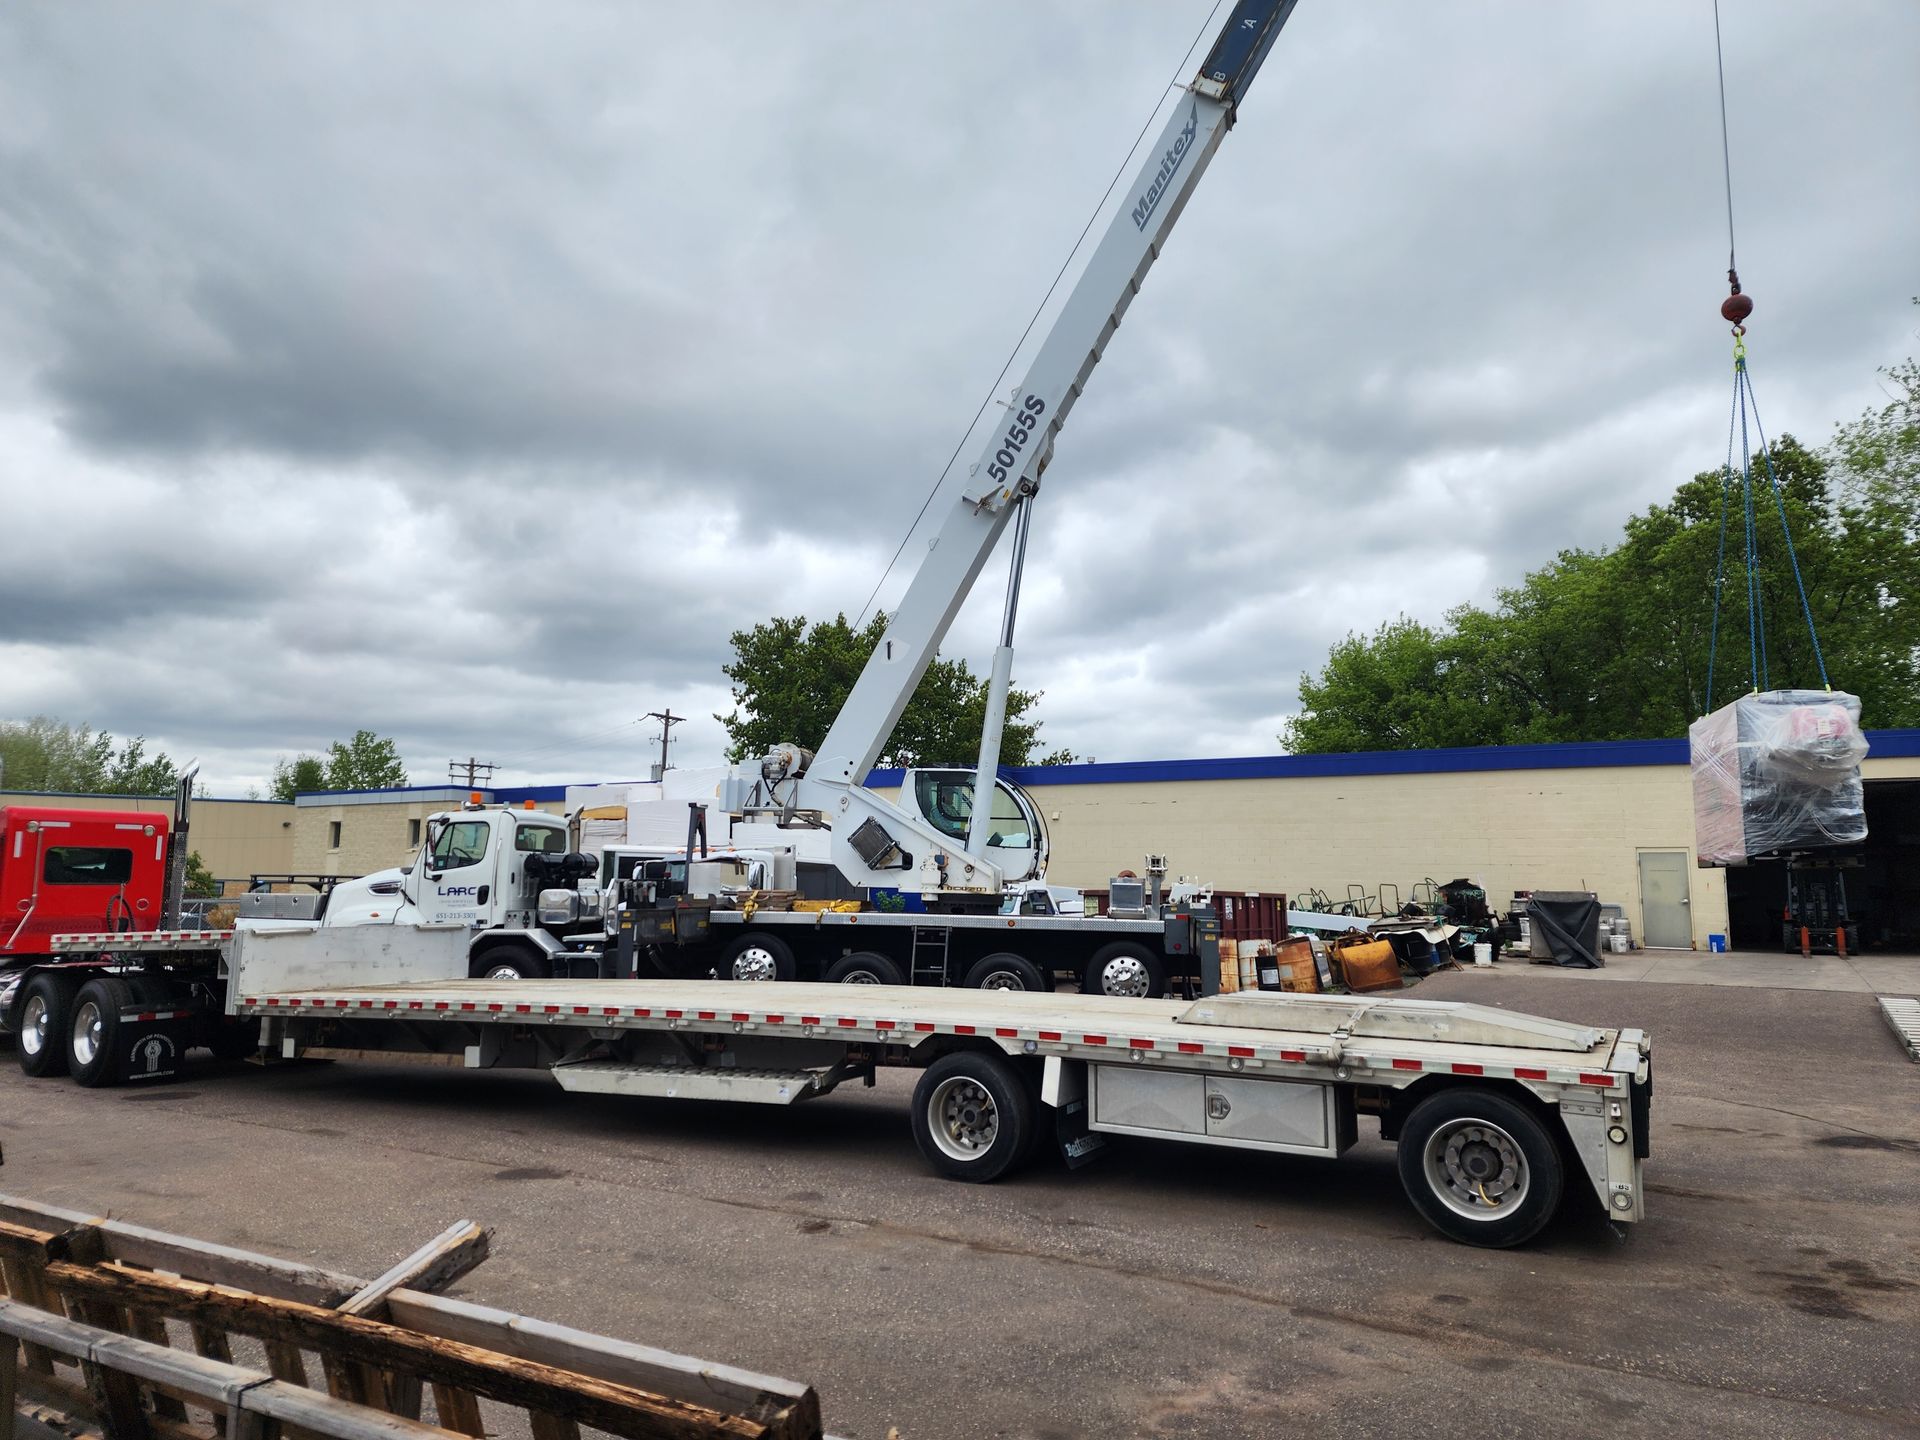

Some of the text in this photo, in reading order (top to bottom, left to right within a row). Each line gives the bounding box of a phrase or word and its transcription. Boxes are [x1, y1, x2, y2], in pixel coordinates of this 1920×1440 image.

[1213, 71, 1226, 81] B
[1131, 120, 1197, 227] Manitex
[987, 394, 1045, 483] 50155S
[437, 886, 477, 896] LARC
